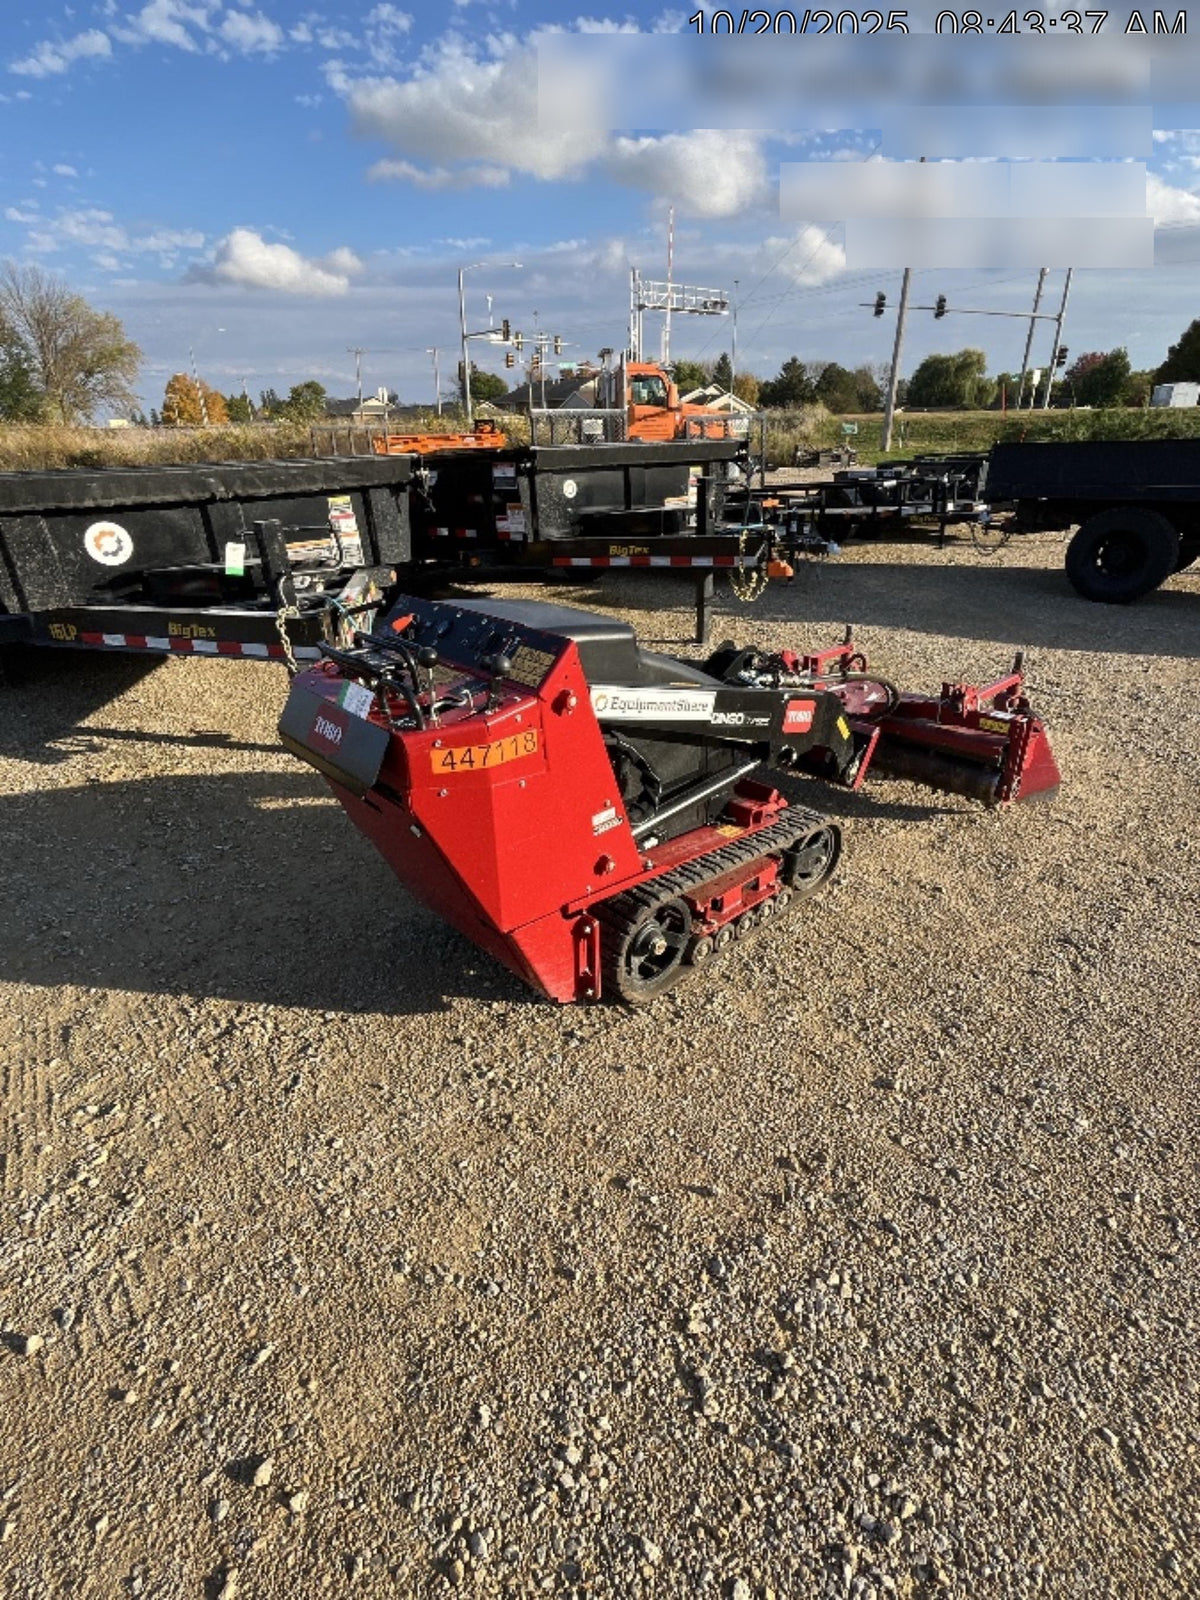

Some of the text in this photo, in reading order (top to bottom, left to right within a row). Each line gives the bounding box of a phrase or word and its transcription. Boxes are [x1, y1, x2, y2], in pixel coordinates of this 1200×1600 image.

[167, 621, 216, 639] BigTex
[610, 696, 709, 714] EquipmentShare
[711, 712, 744, 724] DINGO
[313, 715, 343, 746] TORO
[441, 731, 536, 770] 447118
